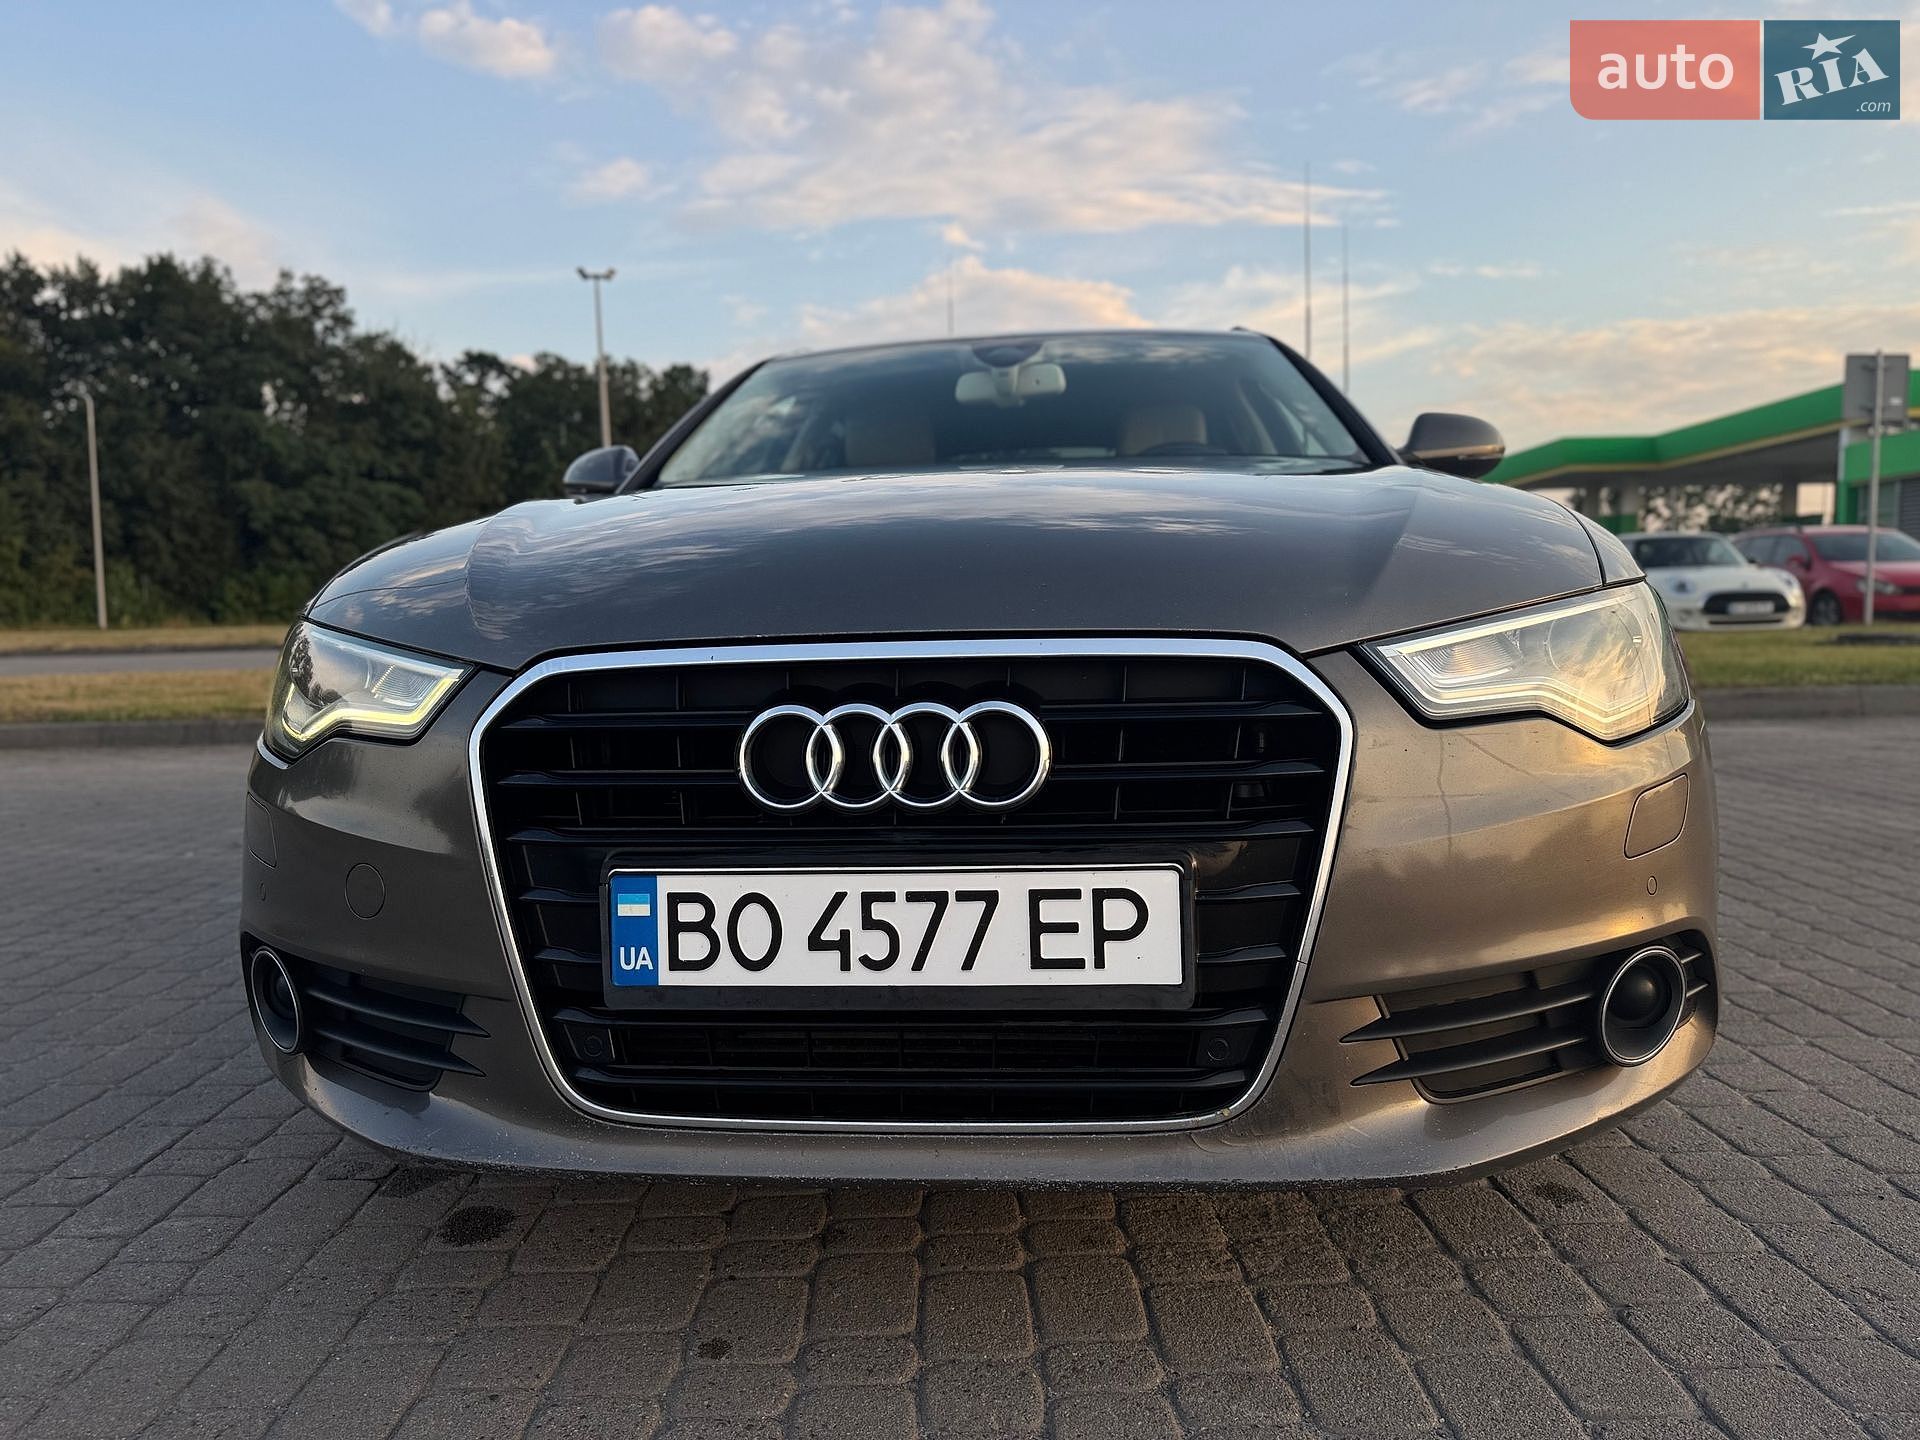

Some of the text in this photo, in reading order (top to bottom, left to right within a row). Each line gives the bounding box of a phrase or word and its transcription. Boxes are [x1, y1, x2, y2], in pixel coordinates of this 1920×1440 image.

[667, 888, 1149, 973] BO 4577 EP
[619, 946, 654, 971] UA
